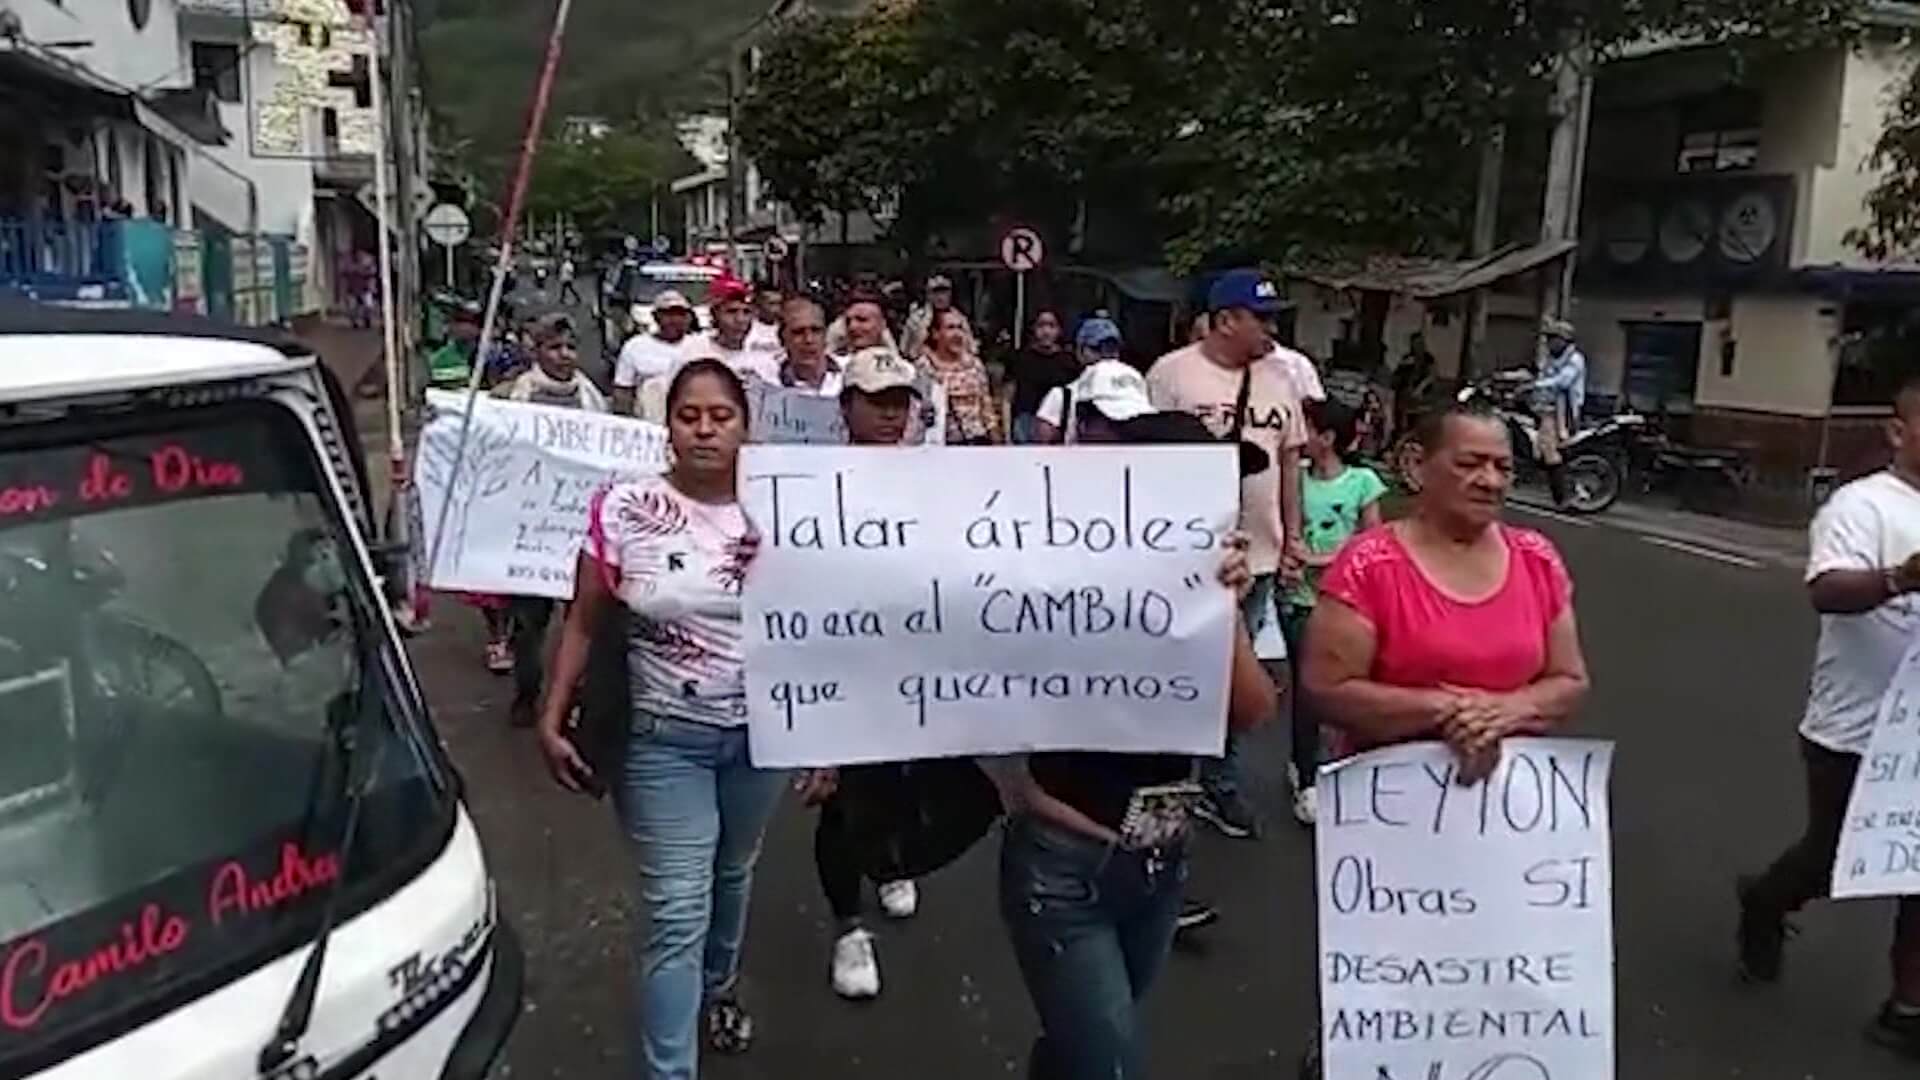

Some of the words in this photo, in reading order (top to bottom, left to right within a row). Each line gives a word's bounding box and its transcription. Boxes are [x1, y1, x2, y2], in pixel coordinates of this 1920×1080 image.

[1012, 236, 1038, 264] R
[0, 486, 55, 512] on
[80, 453, 130, 498] de
[152, 444, 242, 490] Dios
[746, 471, 919, 549] Talar
[966, 466, 1216, 554] árboles
[764, 604, 807, 641] no
[823, 606, 884, 638] era
[770, 681, 846, 732] que
[899, 672, 1200, 728] queriamos
[1331, 855, 1477, 916] Obras
[1523, 855, 1591, 909] SI
[0, 903, 191, 1028] Camilo
[1326, 951, 1574, 986] DESASTRE
[1329, 1009, 1600, 1042] AMBIENTAL
